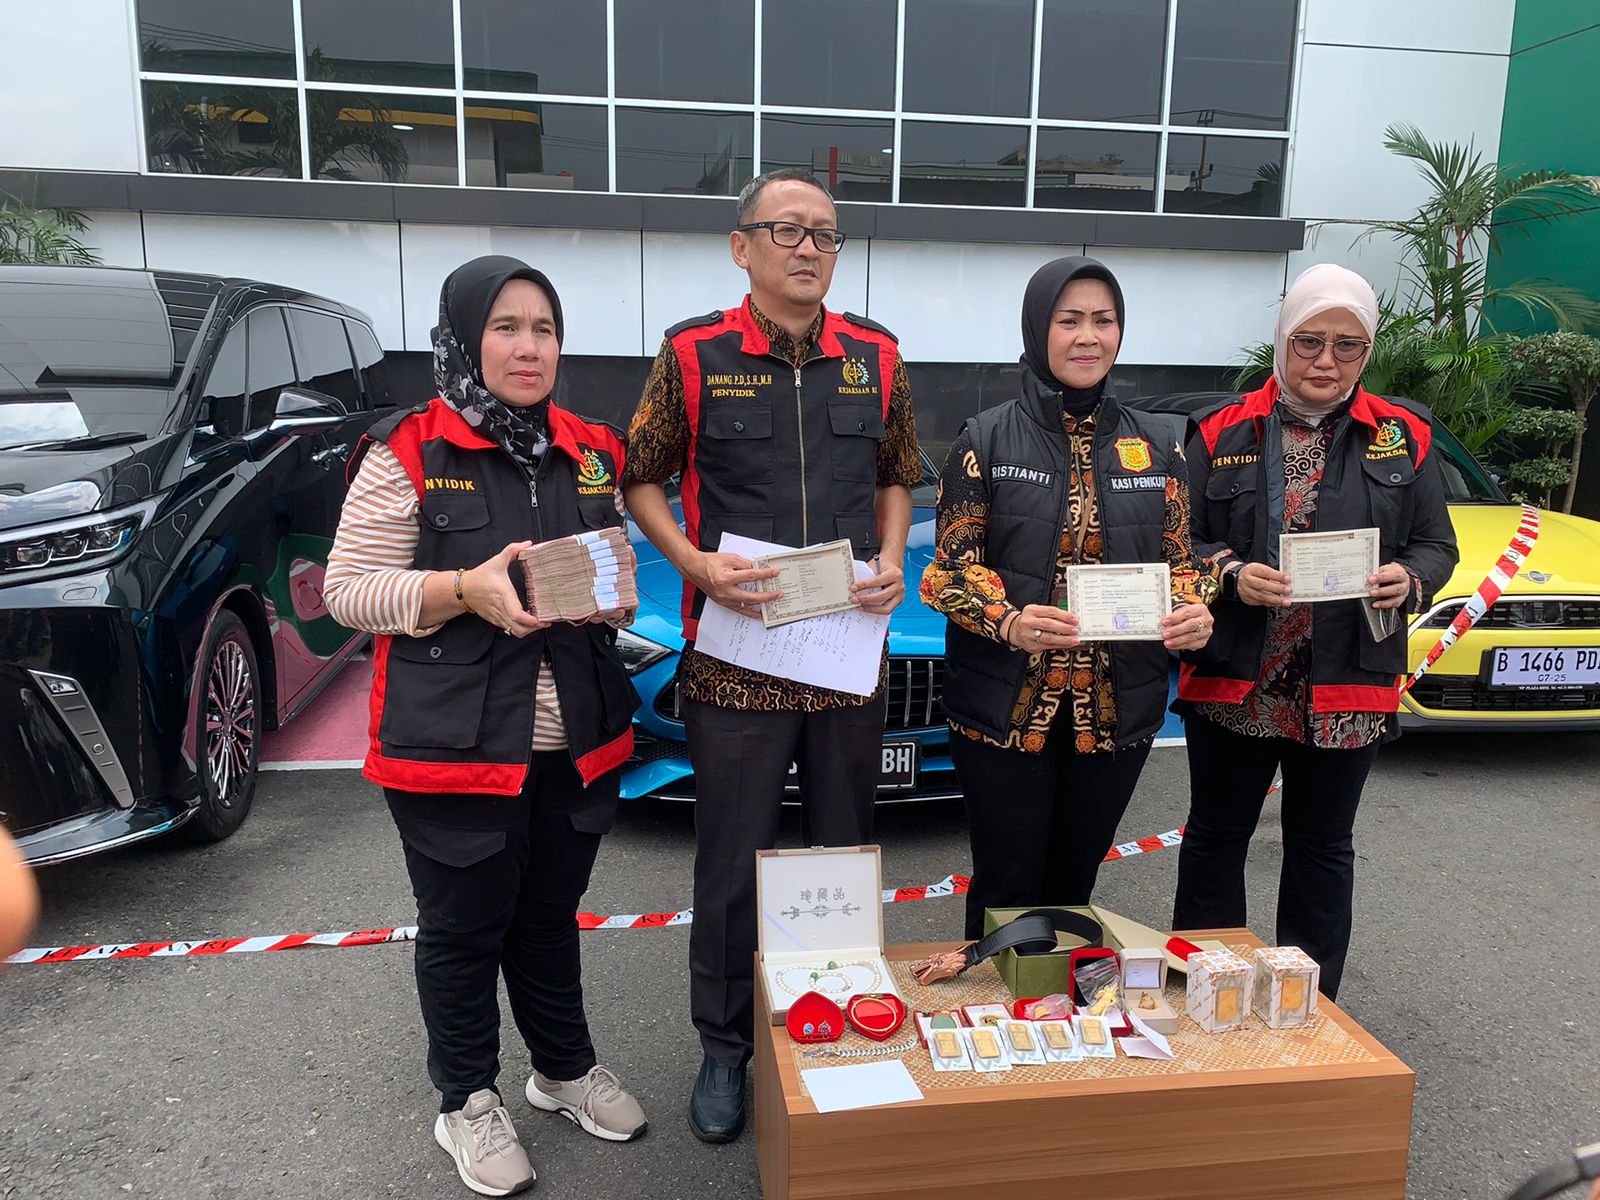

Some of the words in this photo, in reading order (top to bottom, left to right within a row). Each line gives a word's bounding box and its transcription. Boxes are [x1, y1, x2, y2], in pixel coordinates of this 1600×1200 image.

[706, 375, 733, 386] DANANG
[711, 388, 756, 398] PENYIDIK
[1211, 454, 1261, 469] PENYIDI
[991, 465, 1050, 485] RISTIANTI
[1110, 478, 1133, 490] KASI
[1497, 652, 1508, 672] B
[1519, 651, 1565, 672] 1466
[1575, 650, 1600, 670] PD
[881, 748, 909, 773] BH
